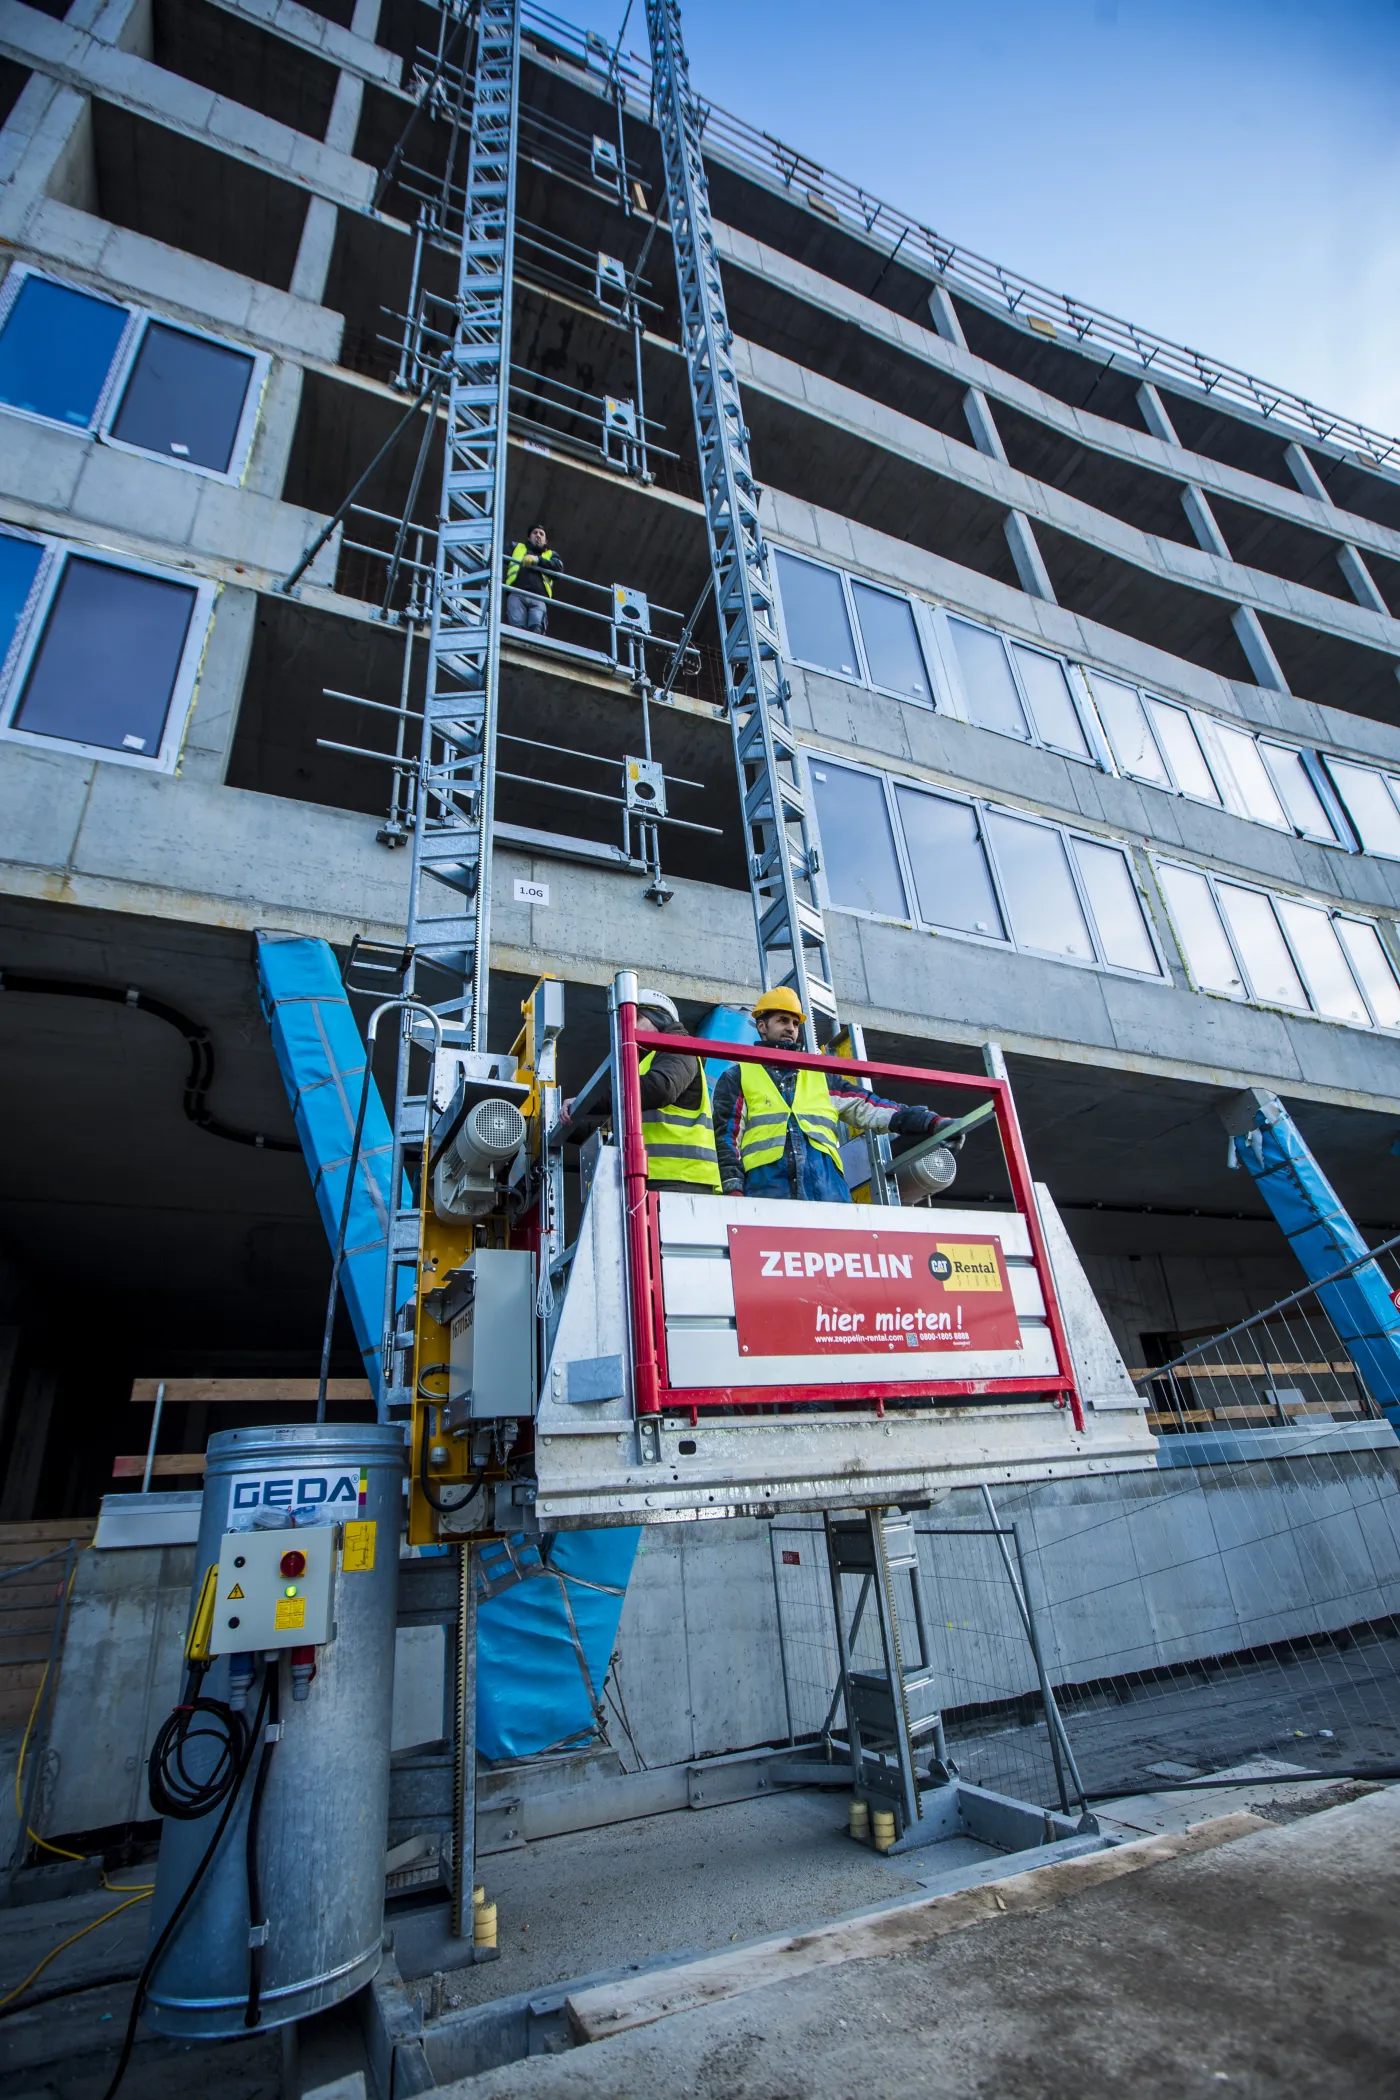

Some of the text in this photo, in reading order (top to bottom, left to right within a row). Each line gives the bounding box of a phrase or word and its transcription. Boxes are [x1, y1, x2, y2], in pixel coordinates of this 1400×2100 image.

[519, 886, 543, 898] 1.OG
[931, 1259, 948, 1273] CAT
[953, 1261, 996, 1274] Rental
[815, 1305, 865, 1332] hier
[814, 1333, 904, 1344] www.zeppelin-rental.com
